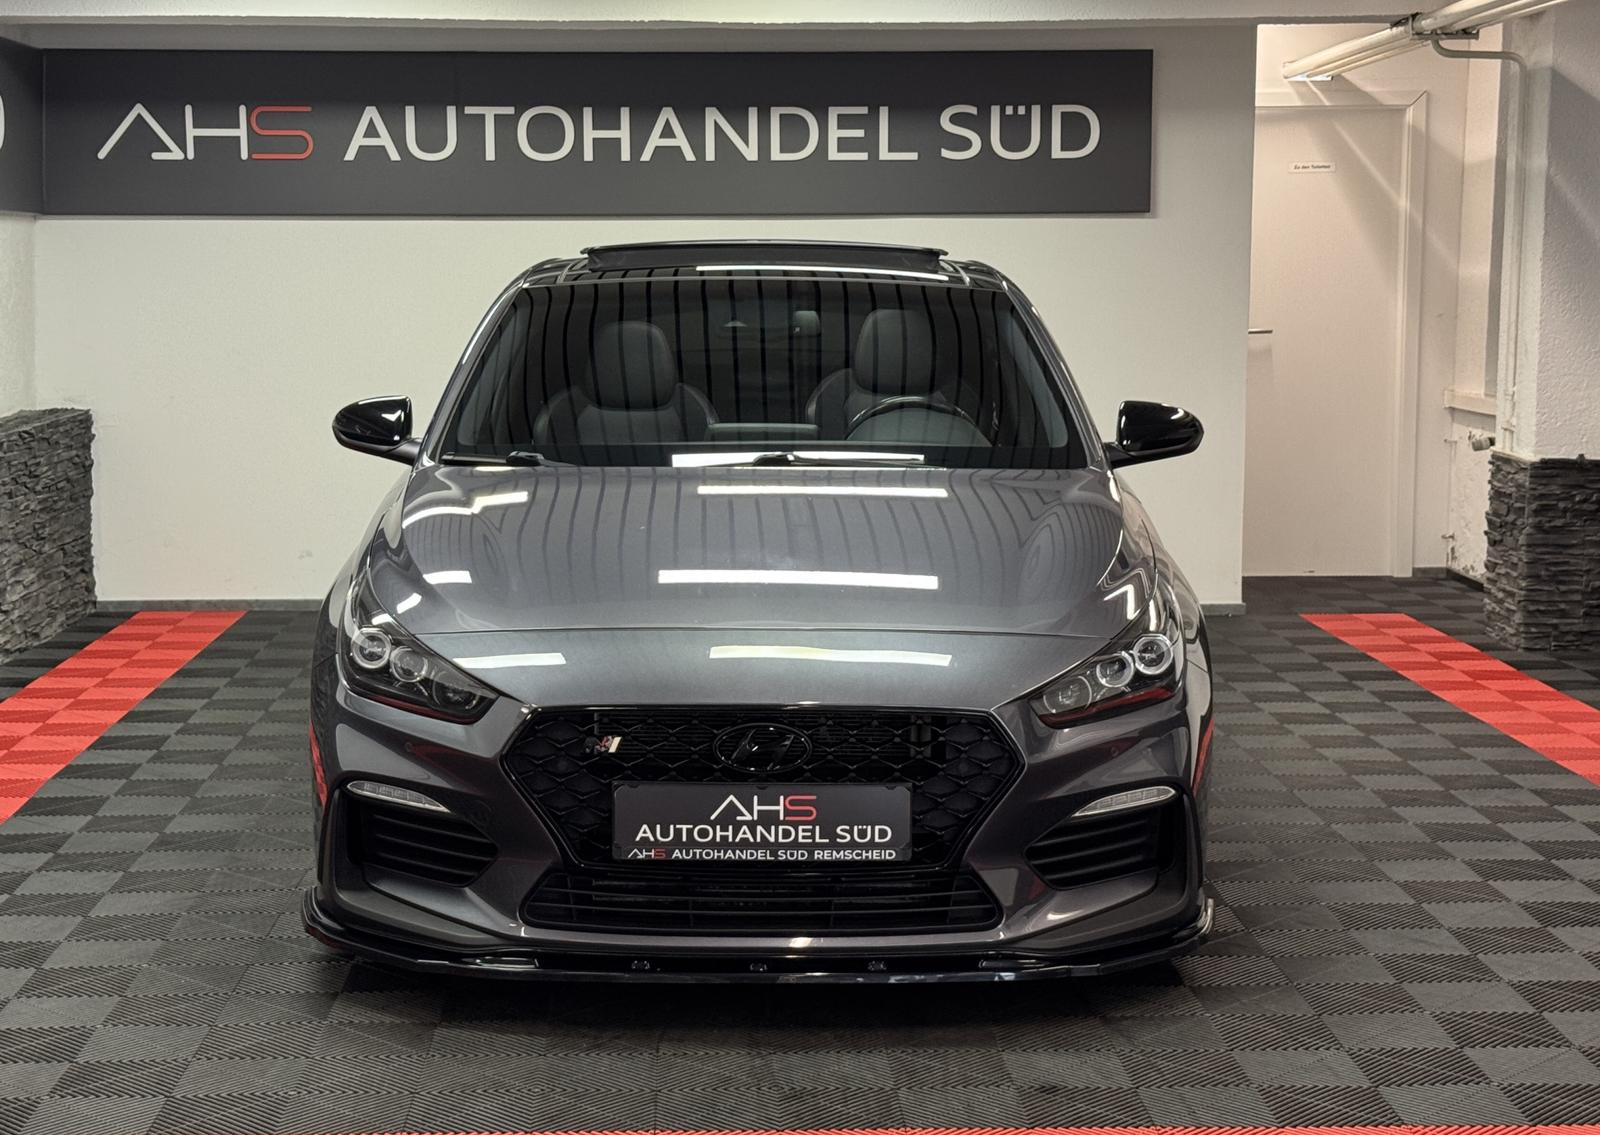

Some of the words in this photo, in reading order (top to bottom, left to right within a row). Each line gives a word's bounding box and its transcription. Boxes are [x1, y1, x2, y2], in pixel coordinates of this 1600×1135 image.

[97, 103, 314, 161] AHS
[343, 105, 919, 162] AUTOHANDEL
[940, 104, 1101, 160] SÜD
[710, 794, 817, 821] AHS
[635, 824, 829, 843] AUTOHANDEL
[835, 824, 893, 843] SÜD
[627, 848, 666, 859] AHS
[671, 848, 776, 860] AUTOHANDEL
[777, 848, 809, 861] SÜD
[813, 849, 897, 861] REMSCHEID
